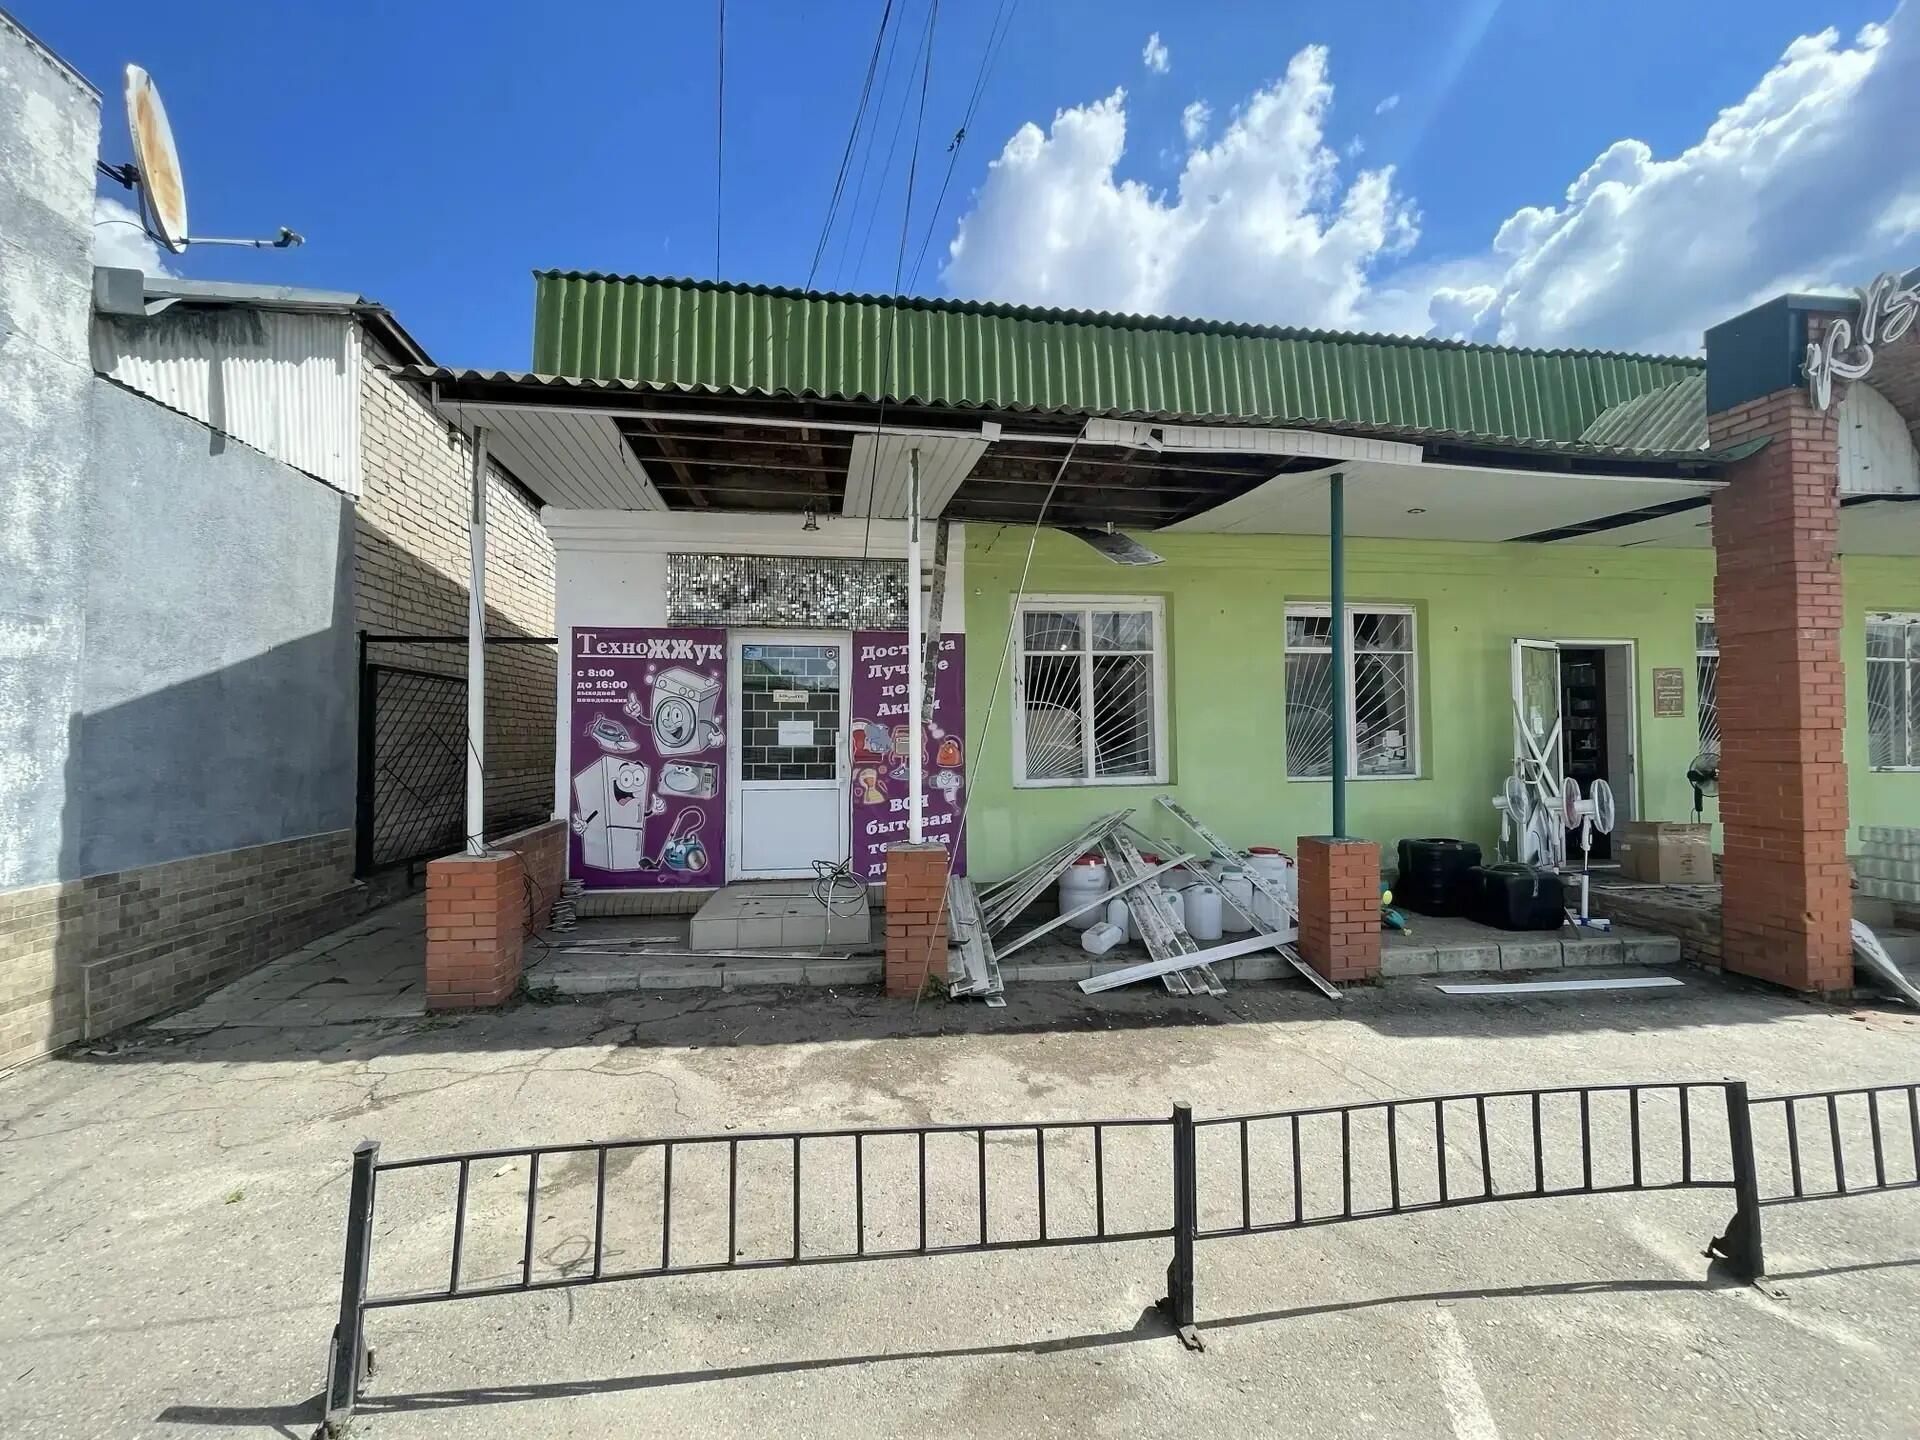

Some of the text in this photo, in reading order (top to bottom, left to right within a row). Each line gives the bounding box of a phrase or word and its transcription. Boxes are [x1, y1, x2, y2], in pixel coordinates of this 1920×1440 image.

[588, 669, 615, 678] 8:00
[868, 659, 949, 681] Луче
[577, 680, 628, 690] до 16:00
[865, 813, 953, 836] бытвая
